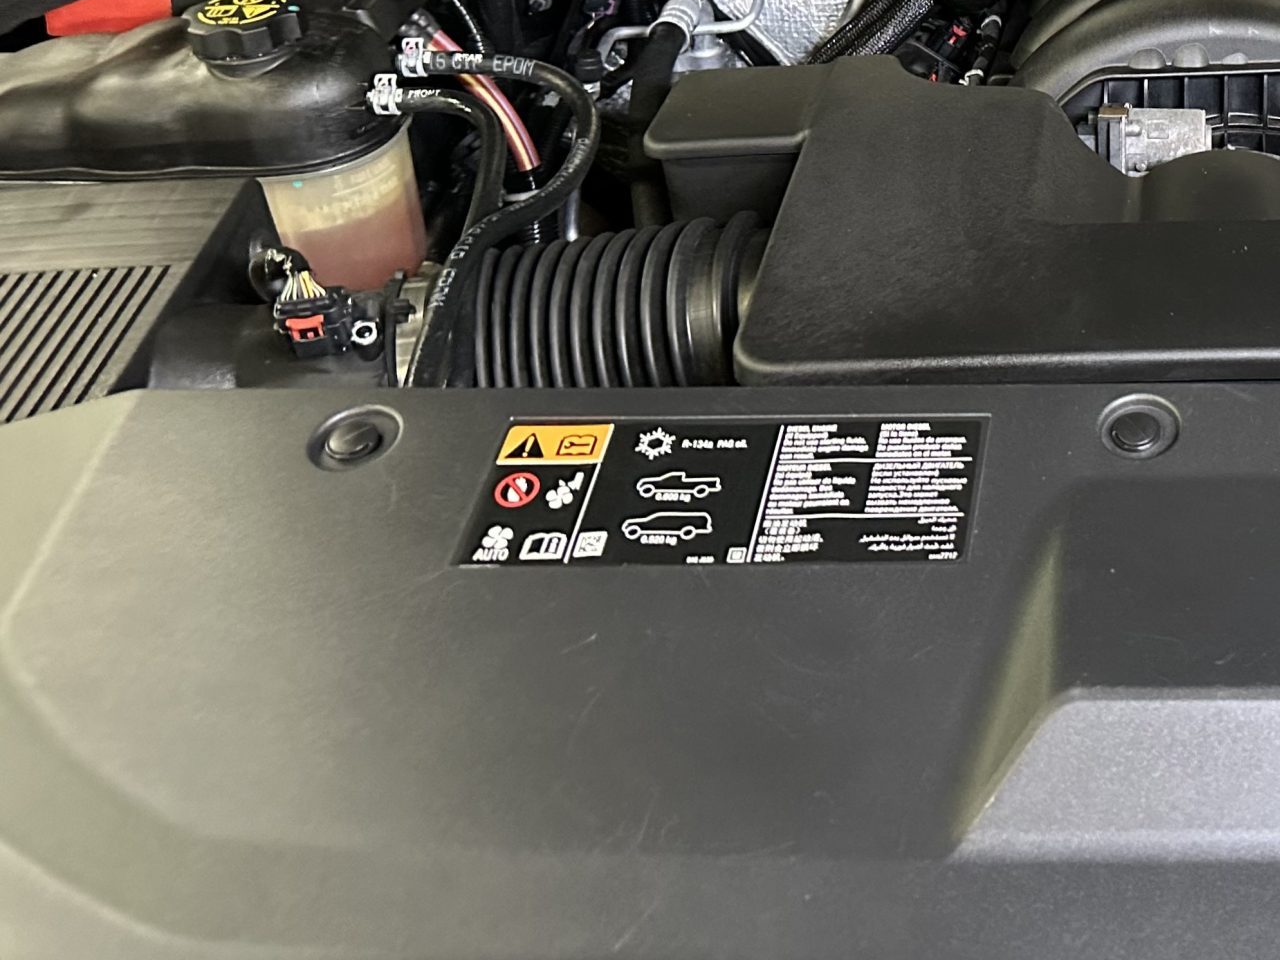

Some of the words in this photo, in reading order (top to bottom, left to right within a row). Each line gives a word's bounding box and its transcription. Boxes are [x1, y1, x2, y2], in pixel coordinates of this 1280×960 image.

[679, 493, 692, 503] kg
[665, 535, 678, 546] kg
[472, 548, 509, 561] AUTO
